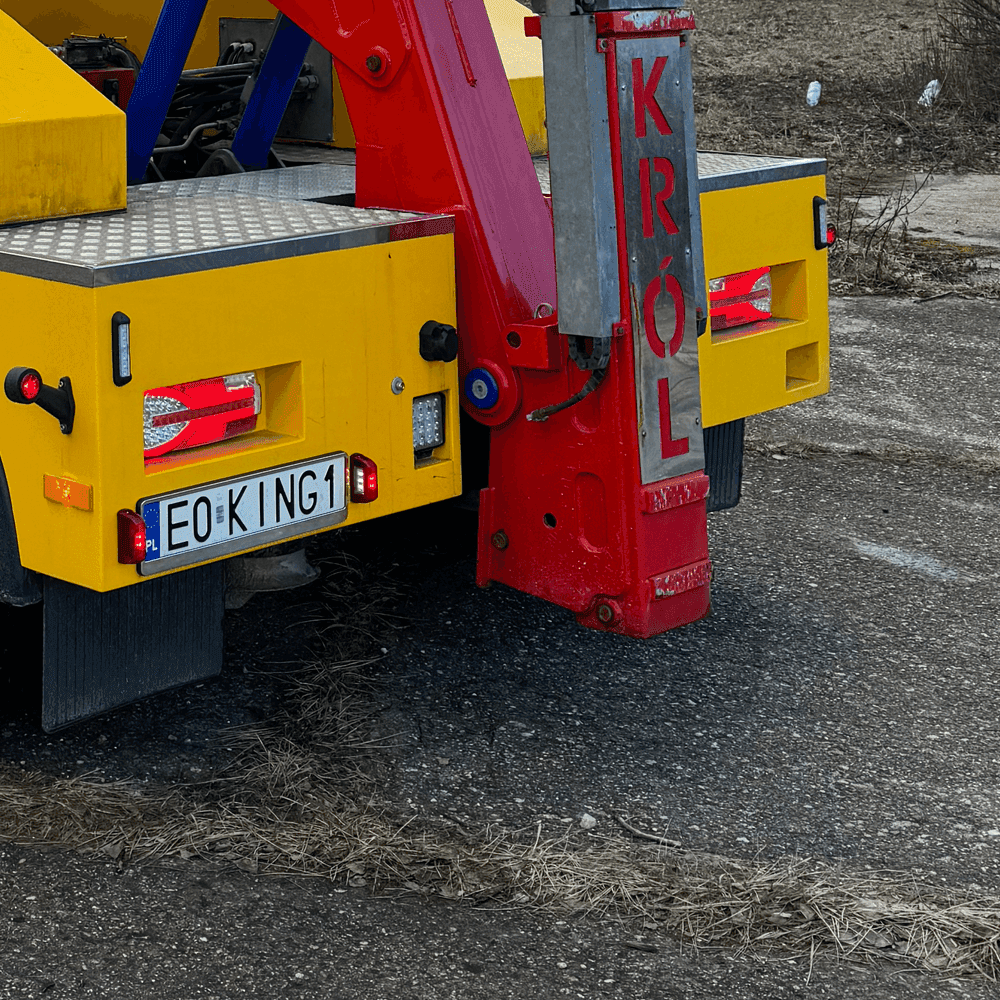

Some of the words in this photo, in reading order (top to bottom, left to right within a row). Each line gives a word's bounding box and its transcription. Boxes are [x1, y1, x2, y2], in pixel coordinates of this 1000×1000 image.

[631, 55, 690, 460] KRÓL
[228, 464, 335, 536] KING1
[145, 538, 158, 552] PL
